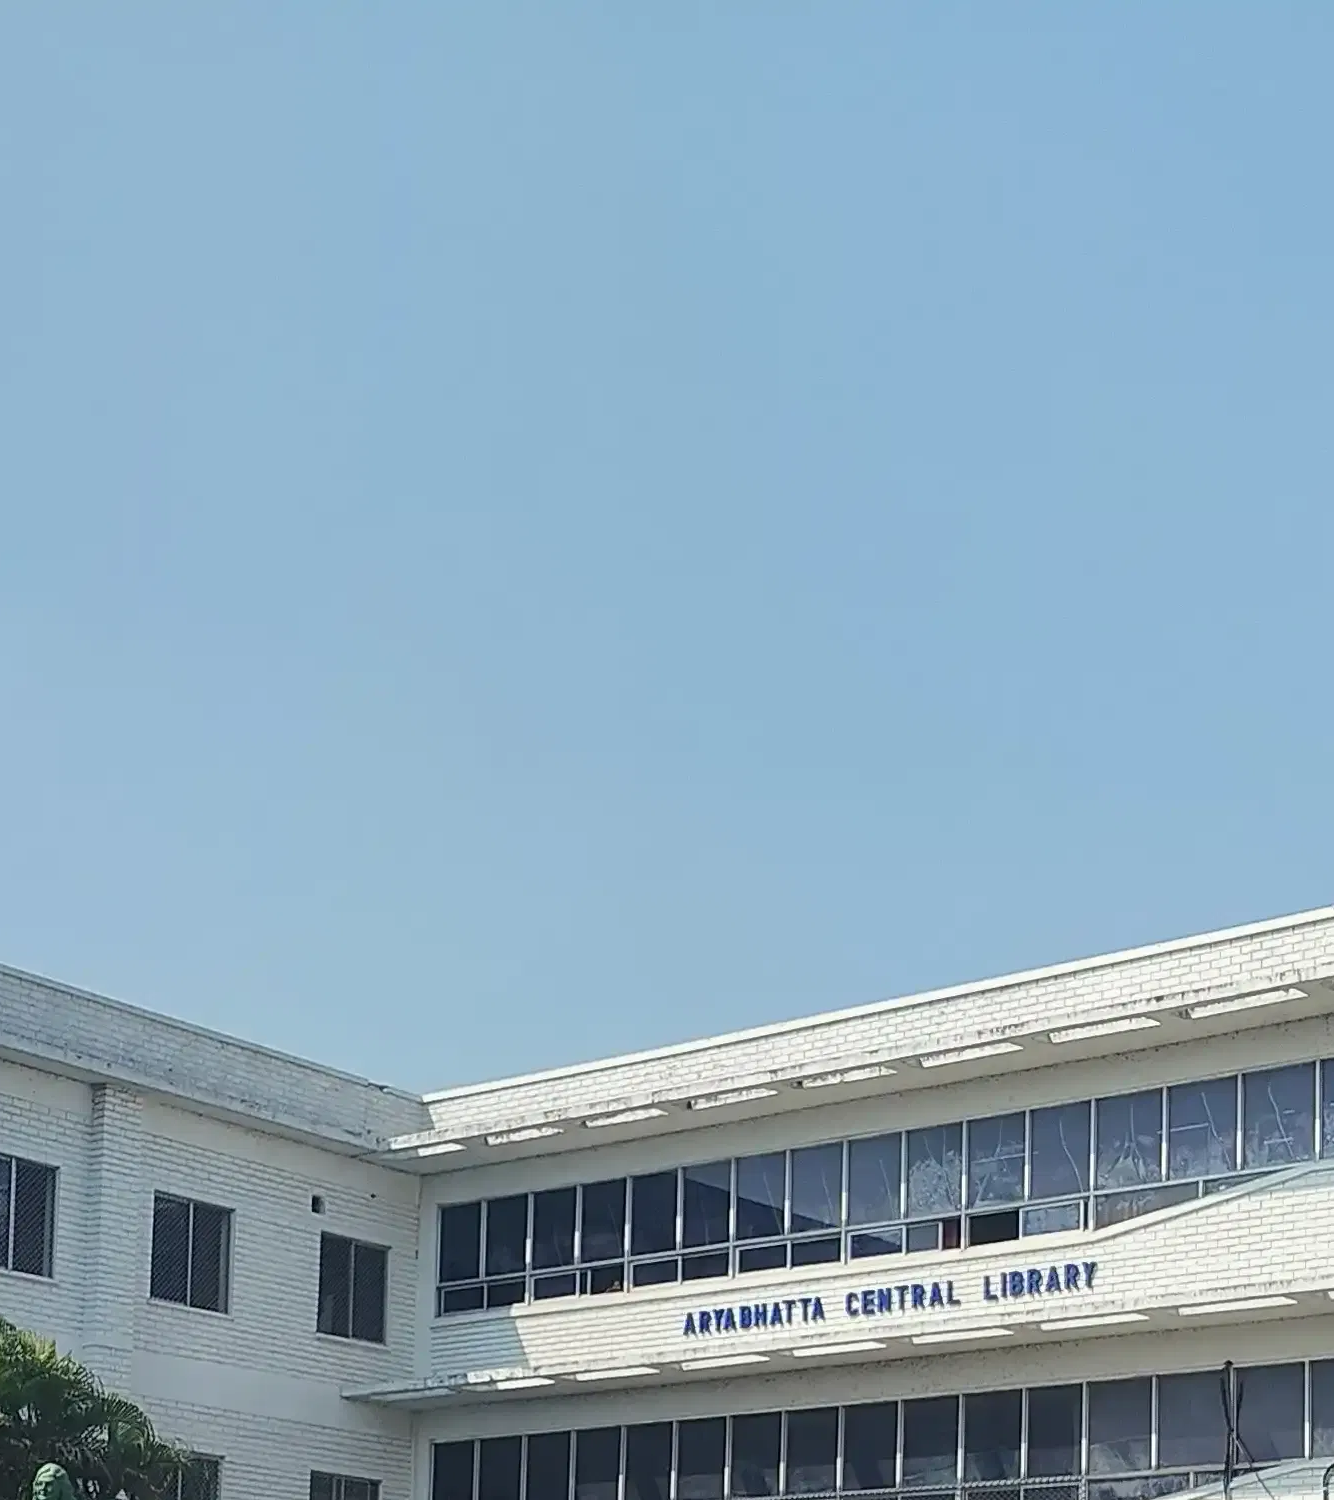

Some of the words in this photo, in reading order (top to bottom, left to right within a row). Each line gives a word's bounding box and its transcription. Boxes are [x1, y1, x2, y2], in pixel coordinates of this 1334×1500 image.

[682, 1296, 826, 1337] ARYABHATTA
[845, 1280, 961, 1318] CENTRAL
[984, 1261, 1098, 1301] LIBRARY
